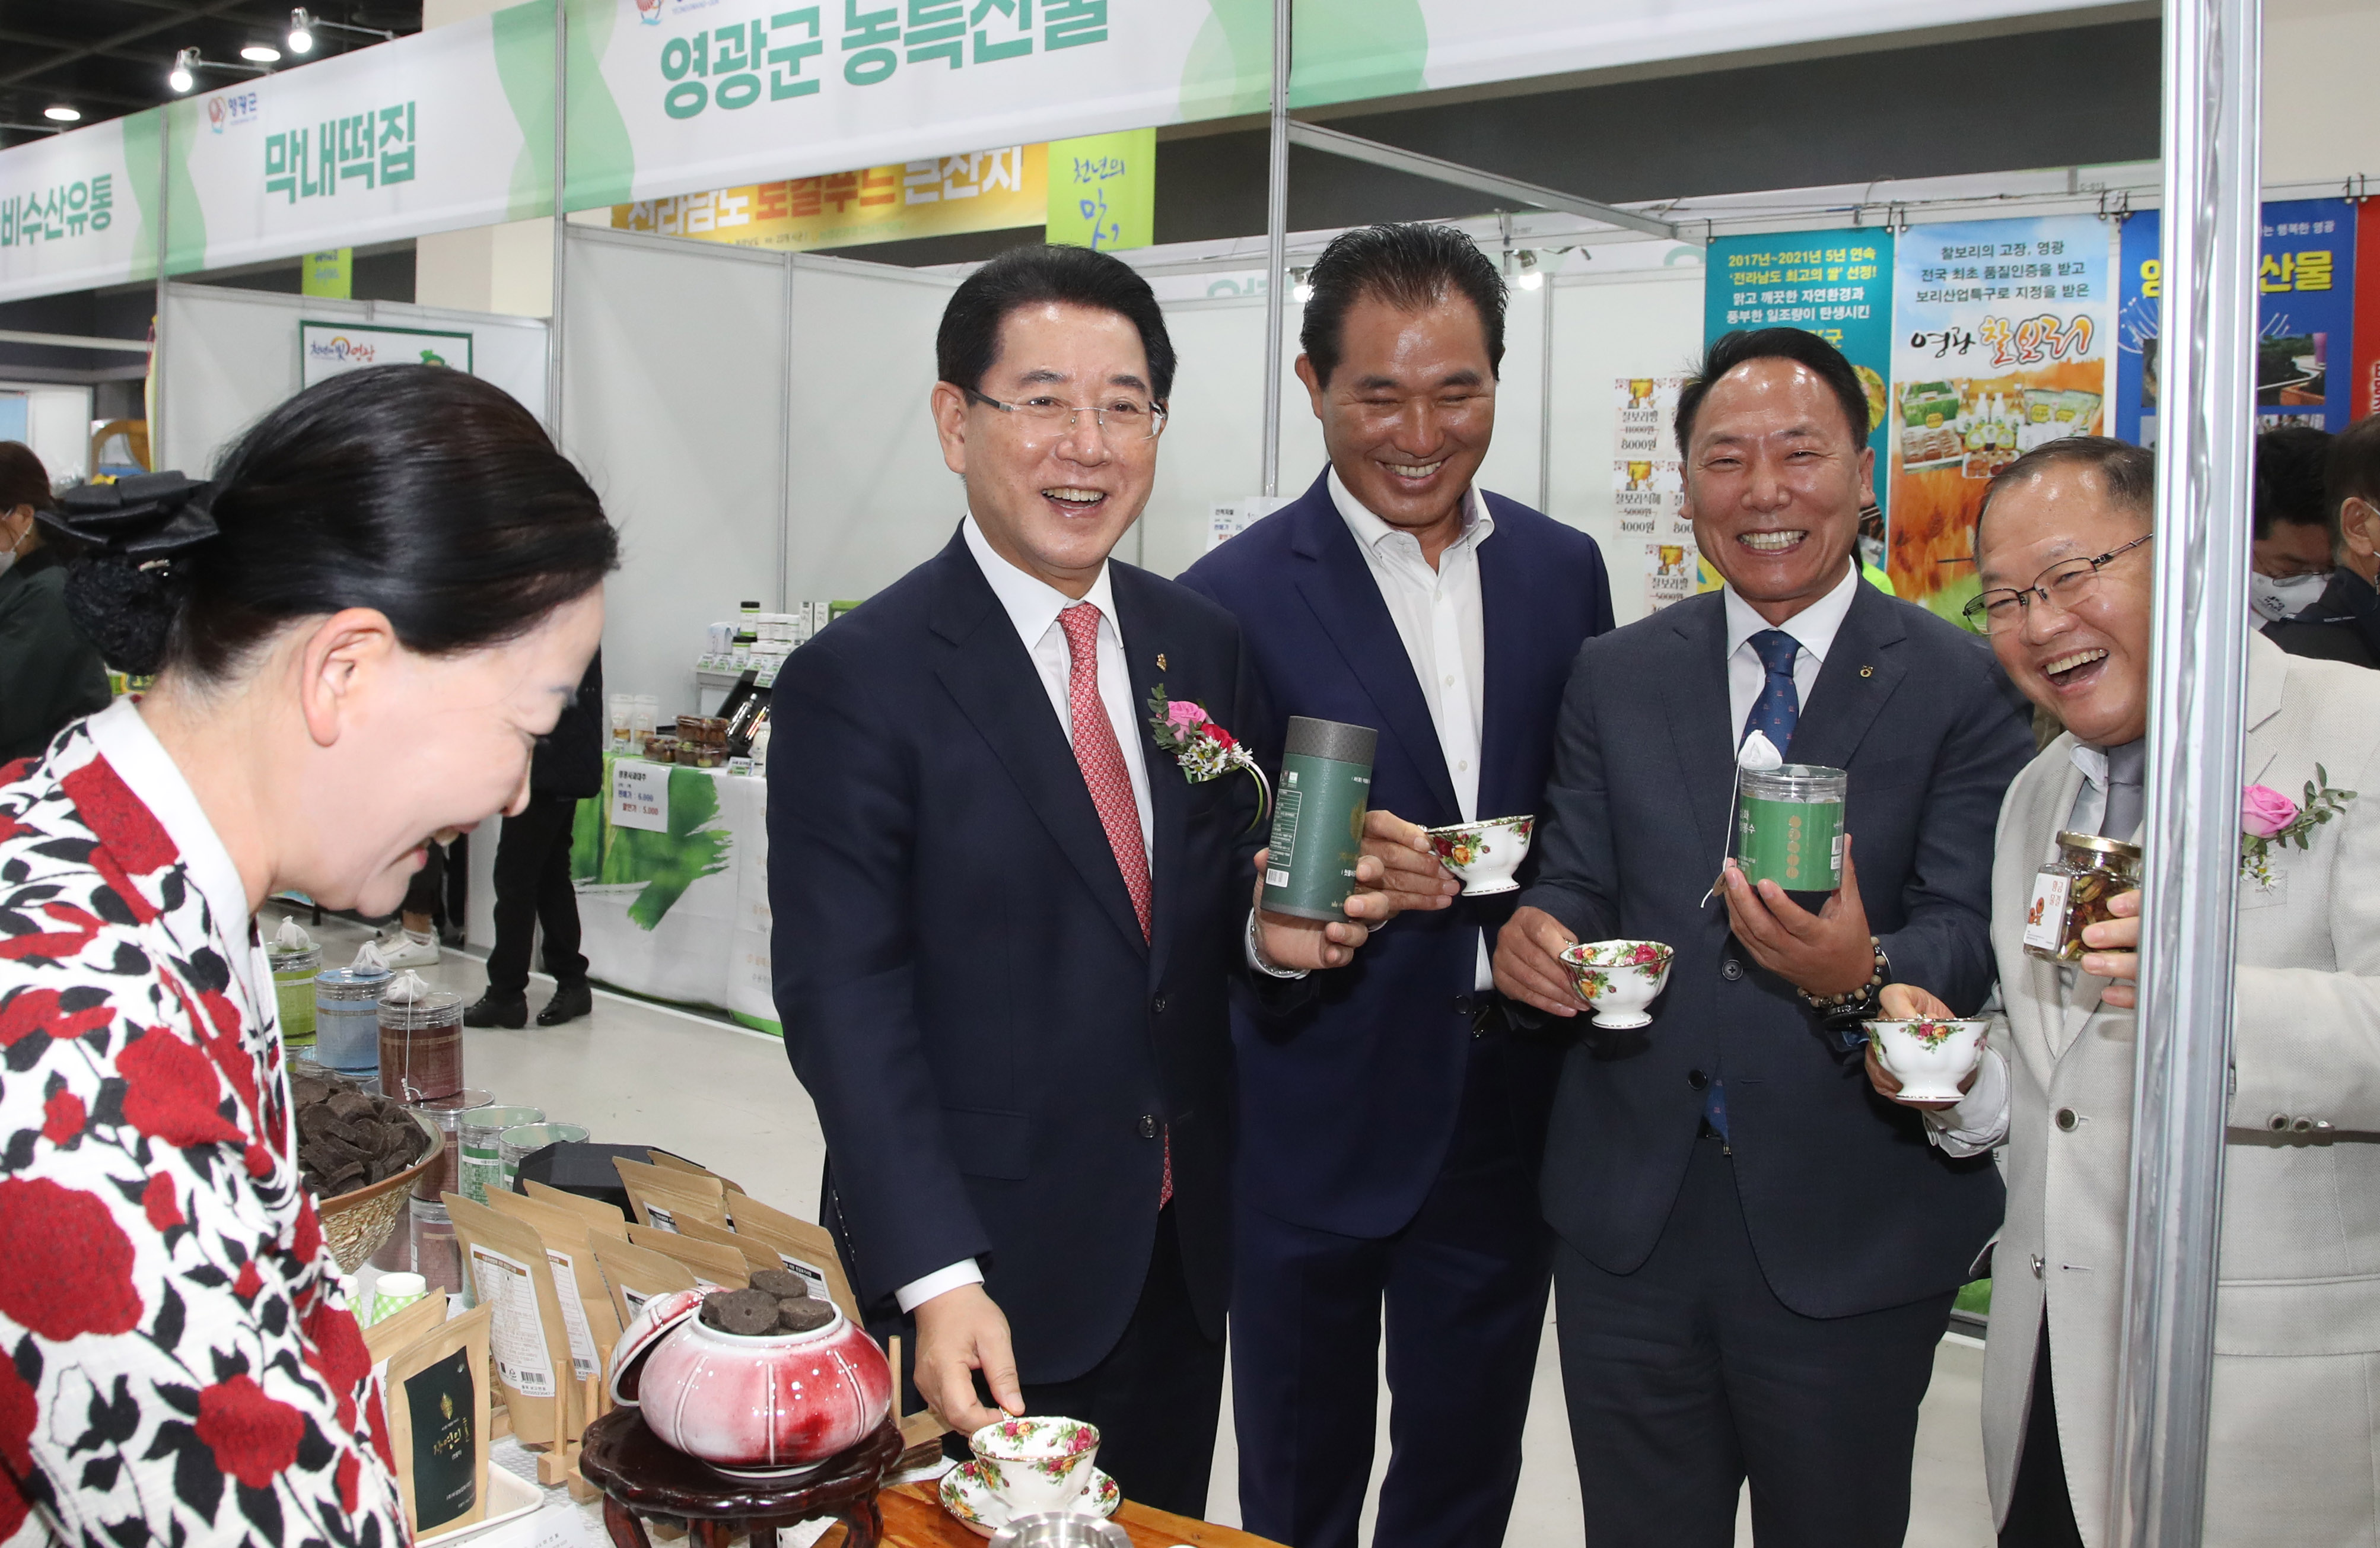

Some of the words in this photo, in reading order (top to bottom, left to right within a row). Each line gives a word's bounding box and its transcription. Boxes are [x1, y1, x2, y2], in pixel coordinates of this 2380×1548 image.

[660, 5, 824, 119] 영광군
[841, 0, 1109, 87] 농특산물
[265, 101, 416, 204] 막내떡집
[2, 173, 113, 247] 비수산유통
[1729, 249, 1822, 267] 2017년~2021년
[1825, 248, 1846, 262] 5년
[1850, 247, 1876, 261] 연속
[1941, 244, 1994, 260] 찰보리의
[2037, 241, 2064, 255] 영광
[1786, 267, 1822, 282] 최고의
[1847, 265, 1877, 280] 선정!
[1921, 268, 1948, 282] 전국
[1952, 266, 1979, 281] 최초
[1984, 263, 2052, 280] 품질인증을
[2058, 262, 2085, 276] 받고
[2260, 250, 2334, 293] 산물
[1733, 292, 1757, 306] 맑고
[1761, 290, 1798, 304] 깨끗한
[1802, 286, 1864, 303] 자연환경과
[1916, 286, 2010, 303] 보리산업특구로
[2015, 284, 2057, 299] 지정을
[2062, 282, 2089, 298] 받은
[1726, 309, 1762, 324] 풍부한
[1767, 307, 1815, 322] 일조량이
[1819, 304, 1870, 320] 탄생시킨
[1911, 326, 1977, 358] 영광
[1979, 314, 2093, 368] 찰보리
